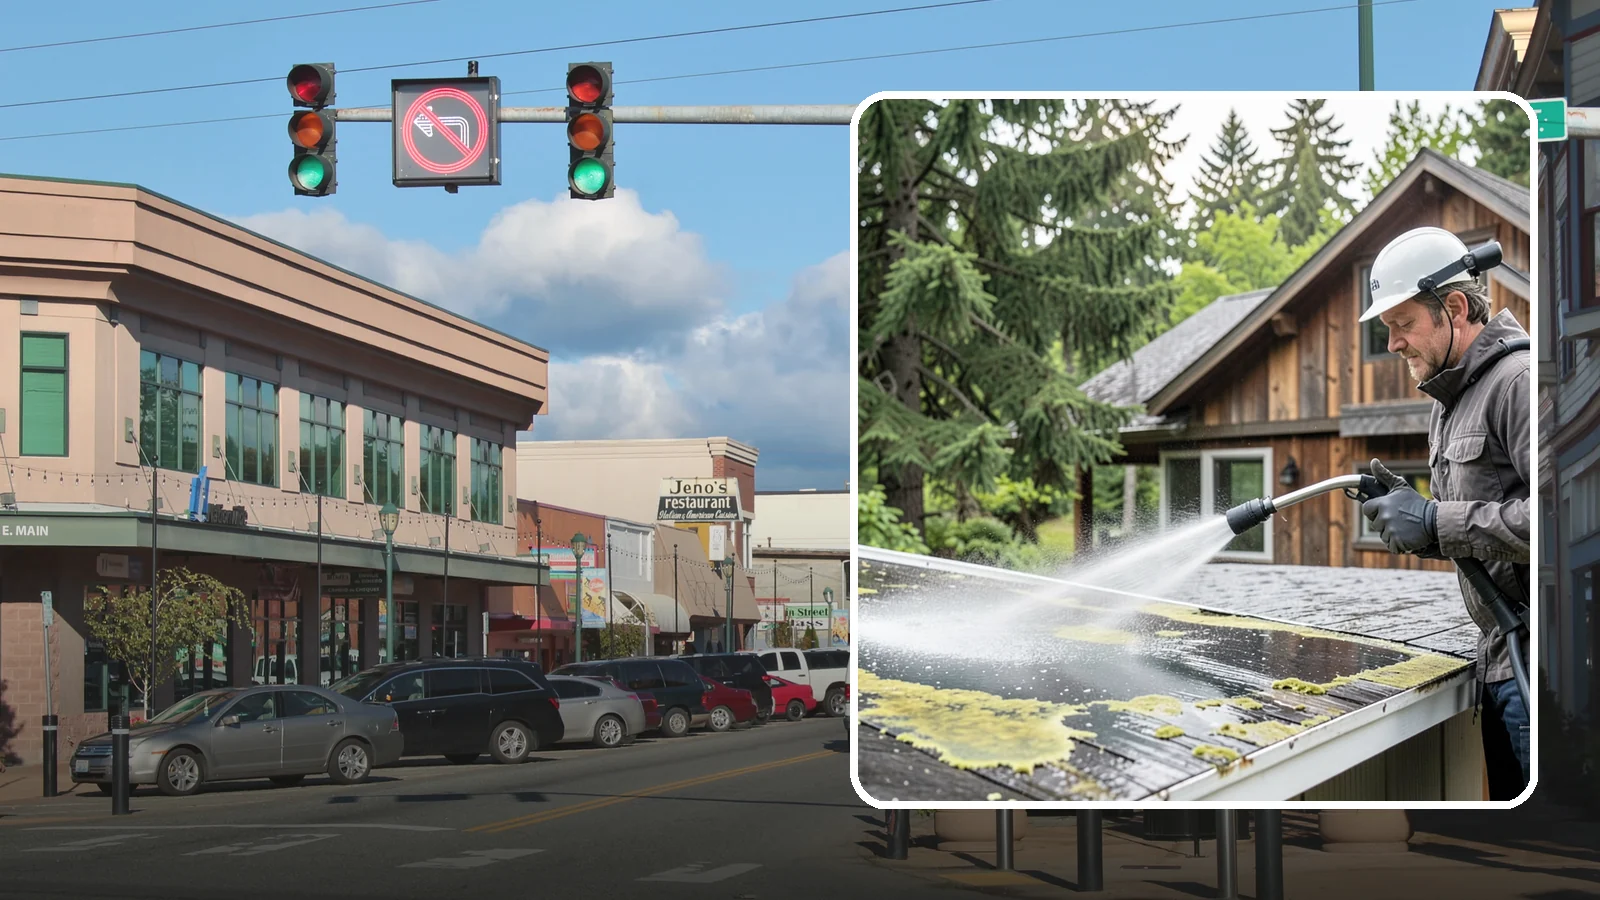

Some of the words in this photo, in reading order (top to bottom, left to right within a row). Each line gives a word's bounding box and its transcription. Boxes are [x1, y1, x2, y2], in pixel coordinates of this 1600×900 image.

[669, 480, 728, 495] Jeno's
[665, 496, 731, 509] restaurant
[658, 510, 681, 519] Italian
[686, 510, 714, 519] American
[715, 510, 738, 519] Cuisine
[2, 525, 13, 536] E.
[15, 525, 49, 536] MAIN
[797, 607, 829, 617] Street
[791, 619, 824, 627] lass
